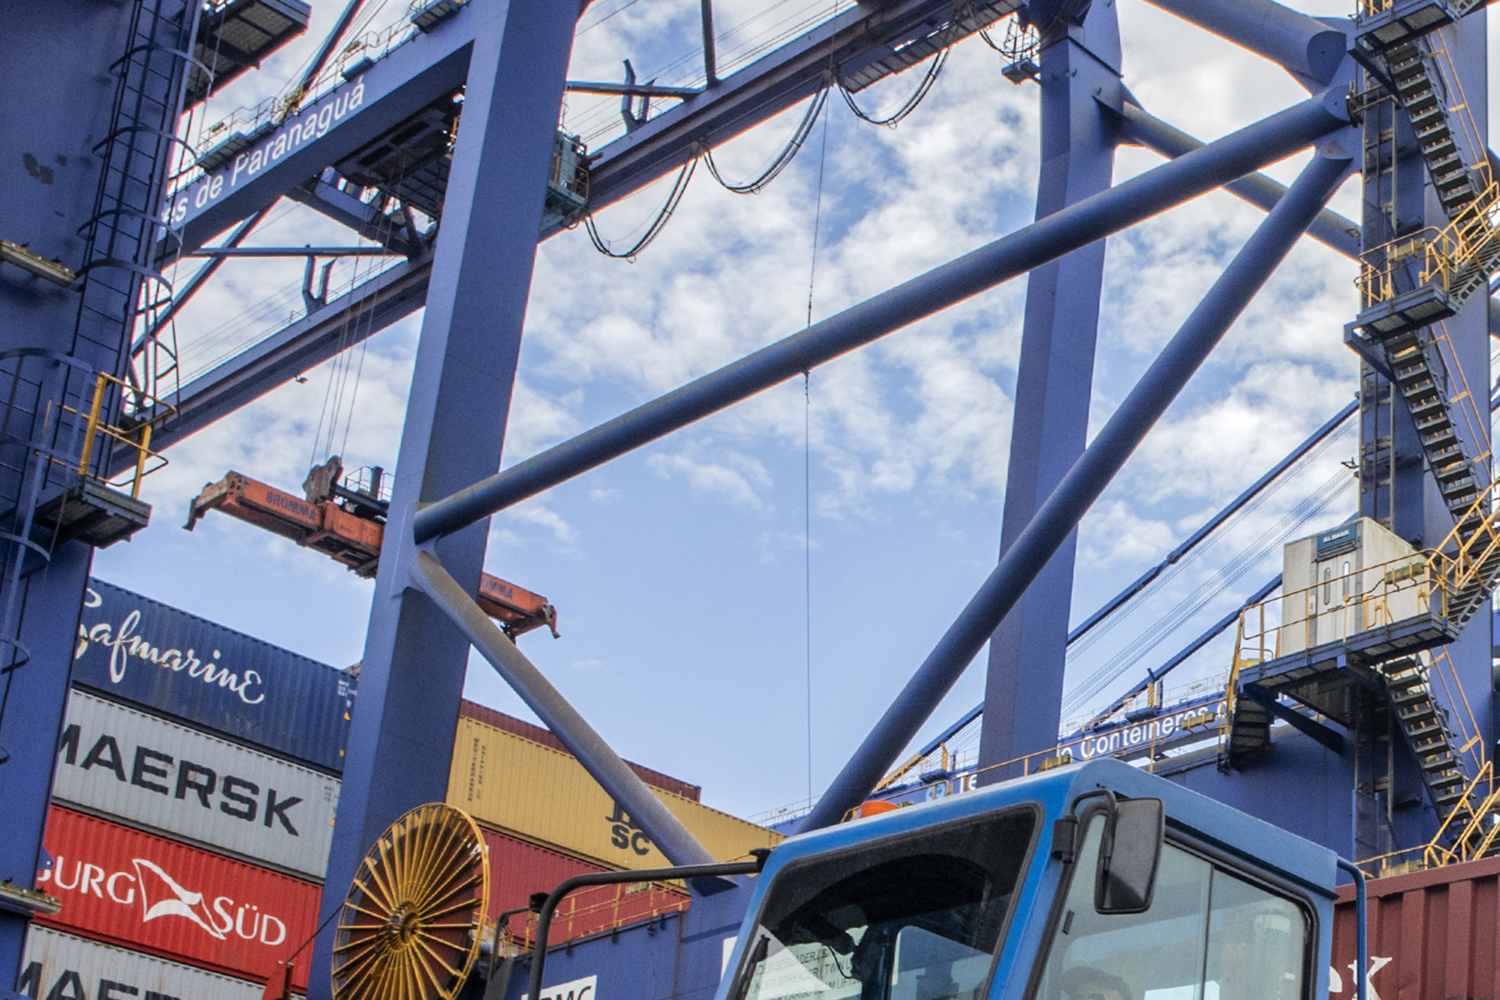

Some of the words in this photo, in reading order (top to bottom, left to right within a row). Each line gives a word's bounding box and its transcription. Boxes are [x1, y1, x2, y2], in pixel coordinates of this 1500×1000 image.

[195, 173, 224, 209] de
[230, 74, 367, 188] Paranaguá
[212, 895, 288, 946] SÜD
